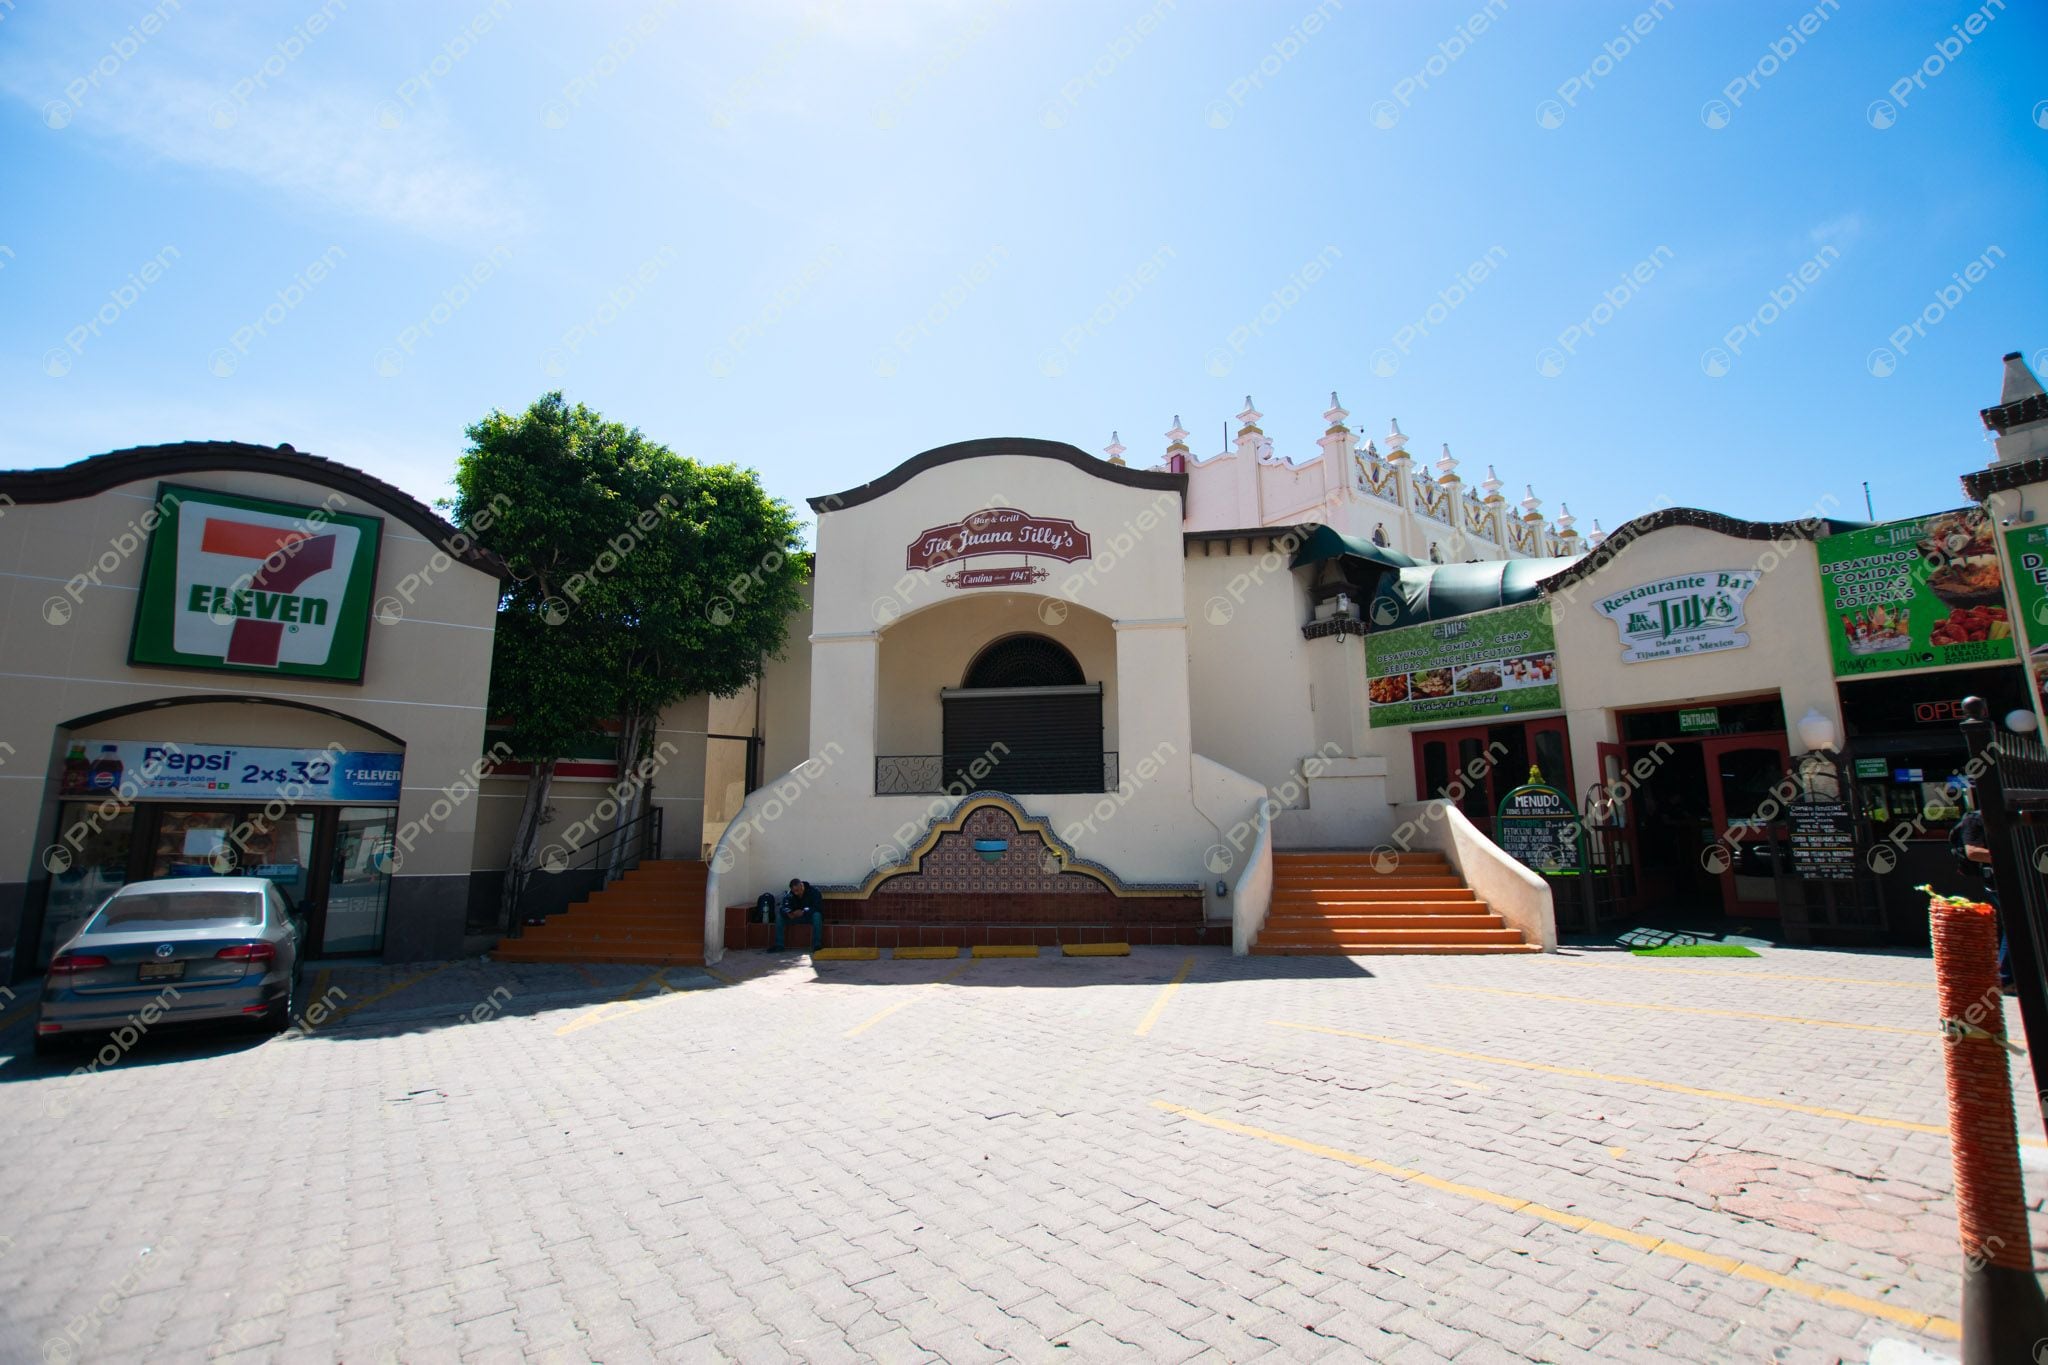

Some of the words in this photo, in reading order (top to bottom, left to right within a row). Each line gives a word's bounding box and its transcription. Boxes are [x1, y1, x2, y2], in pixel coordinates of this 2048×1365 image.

[974, 516, 989, 525] Bar
[999, 514, 1020, 523] Grill
[922, 537, 952, 557] Tia
[957, 529, 1013, 553] Juana
[1018, 525, 1074, 550] Tilly's
[1821, 549, 1919, 576] DESAYUNOS
[963, 574, 993, 585] Cantina
[1009, 570, 1030, 582] 1947
[1833, 563, 1910, 585] COMIDAS
[1602, 575, 1705, 614] Restaurante
[1717, 573, 1752, 590] Bar
[1839, 577, 1907, 597] BEBIDAS
[1835, 588, 1916, 609] BOTANAS
[1377, 647, 1430, 664] DESAYUNOS
[1438, 638, 1484, 654] COMIDAS
[1494, 630, 1531, 645] CENAS
[1656, 637, 1682, 647] Desde
[1686, 634, 1706, 642] 1947
[1384, 661, 1421, 674] BEBIDAS
[1430, 654, 1463, 667] LUNCH
[1464, 644, 1522, 661] EJECUTIVO
[1635, 649, 1670, 660] Tijuana
[1675, 646, 1693, 655] B.C.
[1944, 653, 2000, 664] DOMINGO
[1681, 712, 1717, 727] ENTRADA
[144, 747, 232, 774] Pepsi
[1515, 796, 1559, 807] MENUDO
